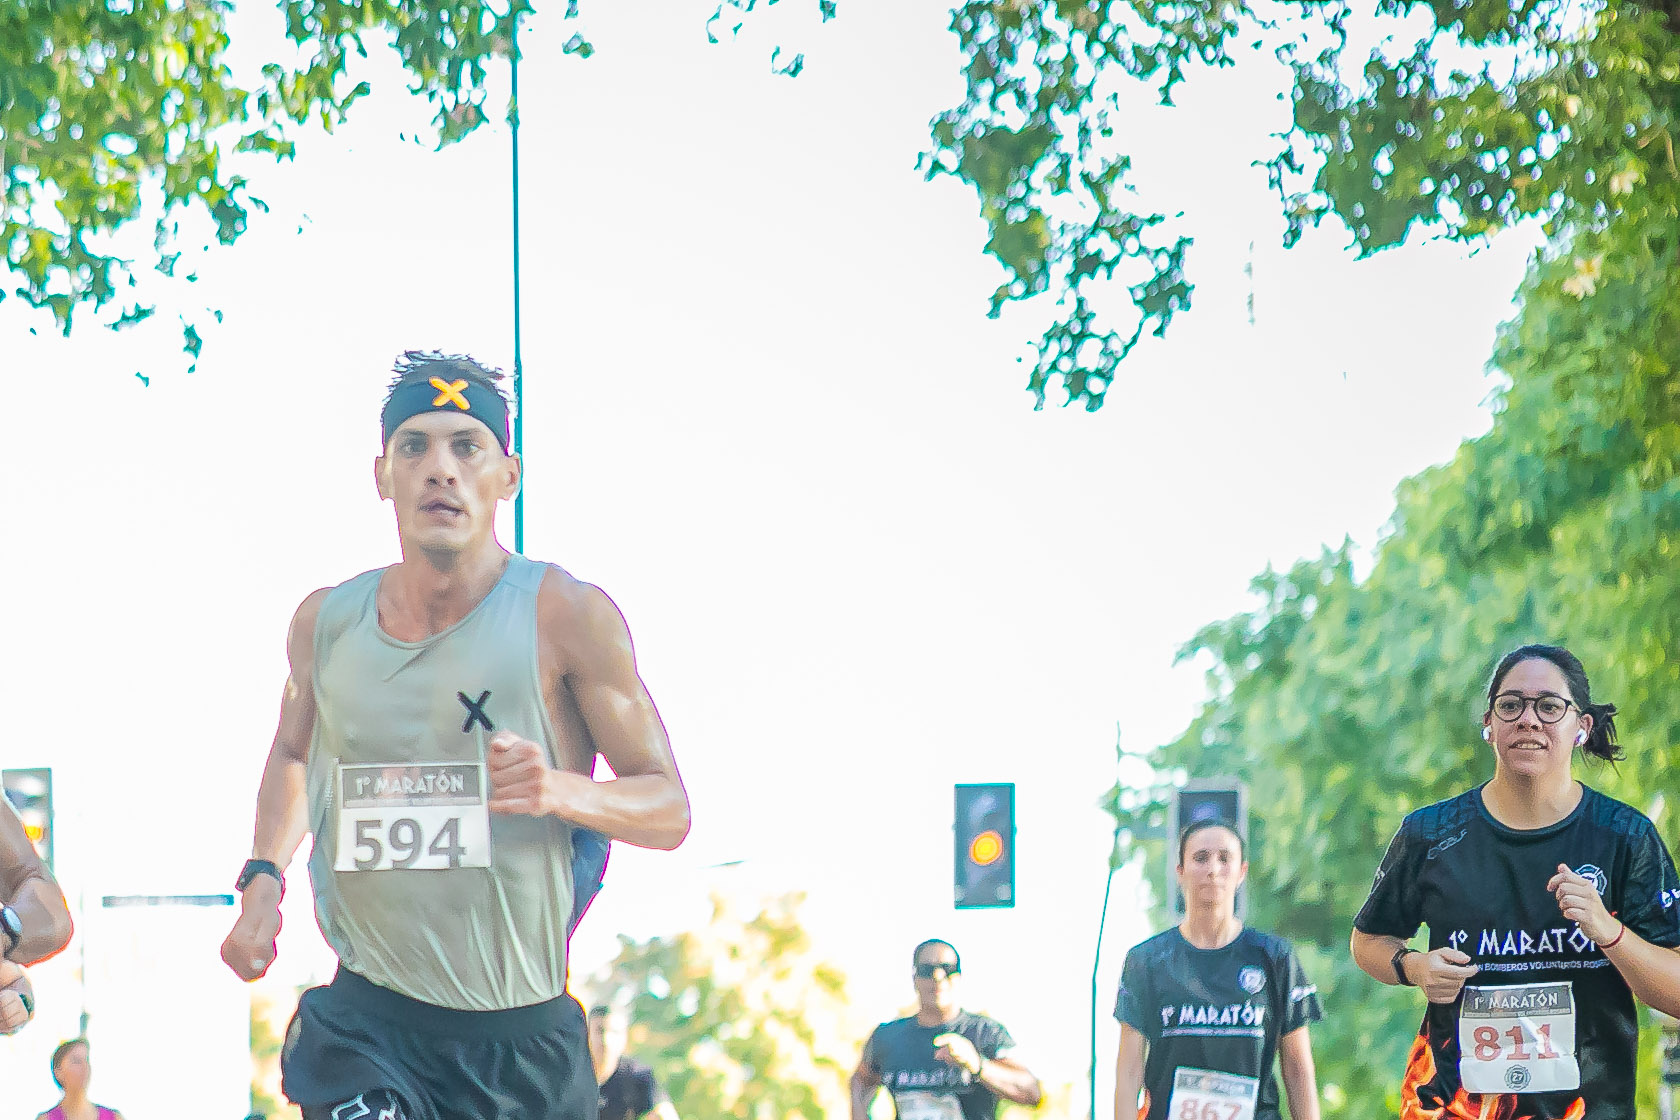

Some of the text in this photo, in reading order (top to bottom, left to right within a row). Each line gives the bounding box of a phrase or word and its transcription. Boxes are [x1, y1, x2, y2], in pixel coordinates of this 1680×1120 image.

[374, 769, 464, 794] MARATÓN
[353, 817, 467, 871] 594
[1489, 989, 1559, 1010] MARATÓN
[1473, 1024, 1560, 1062] 811
